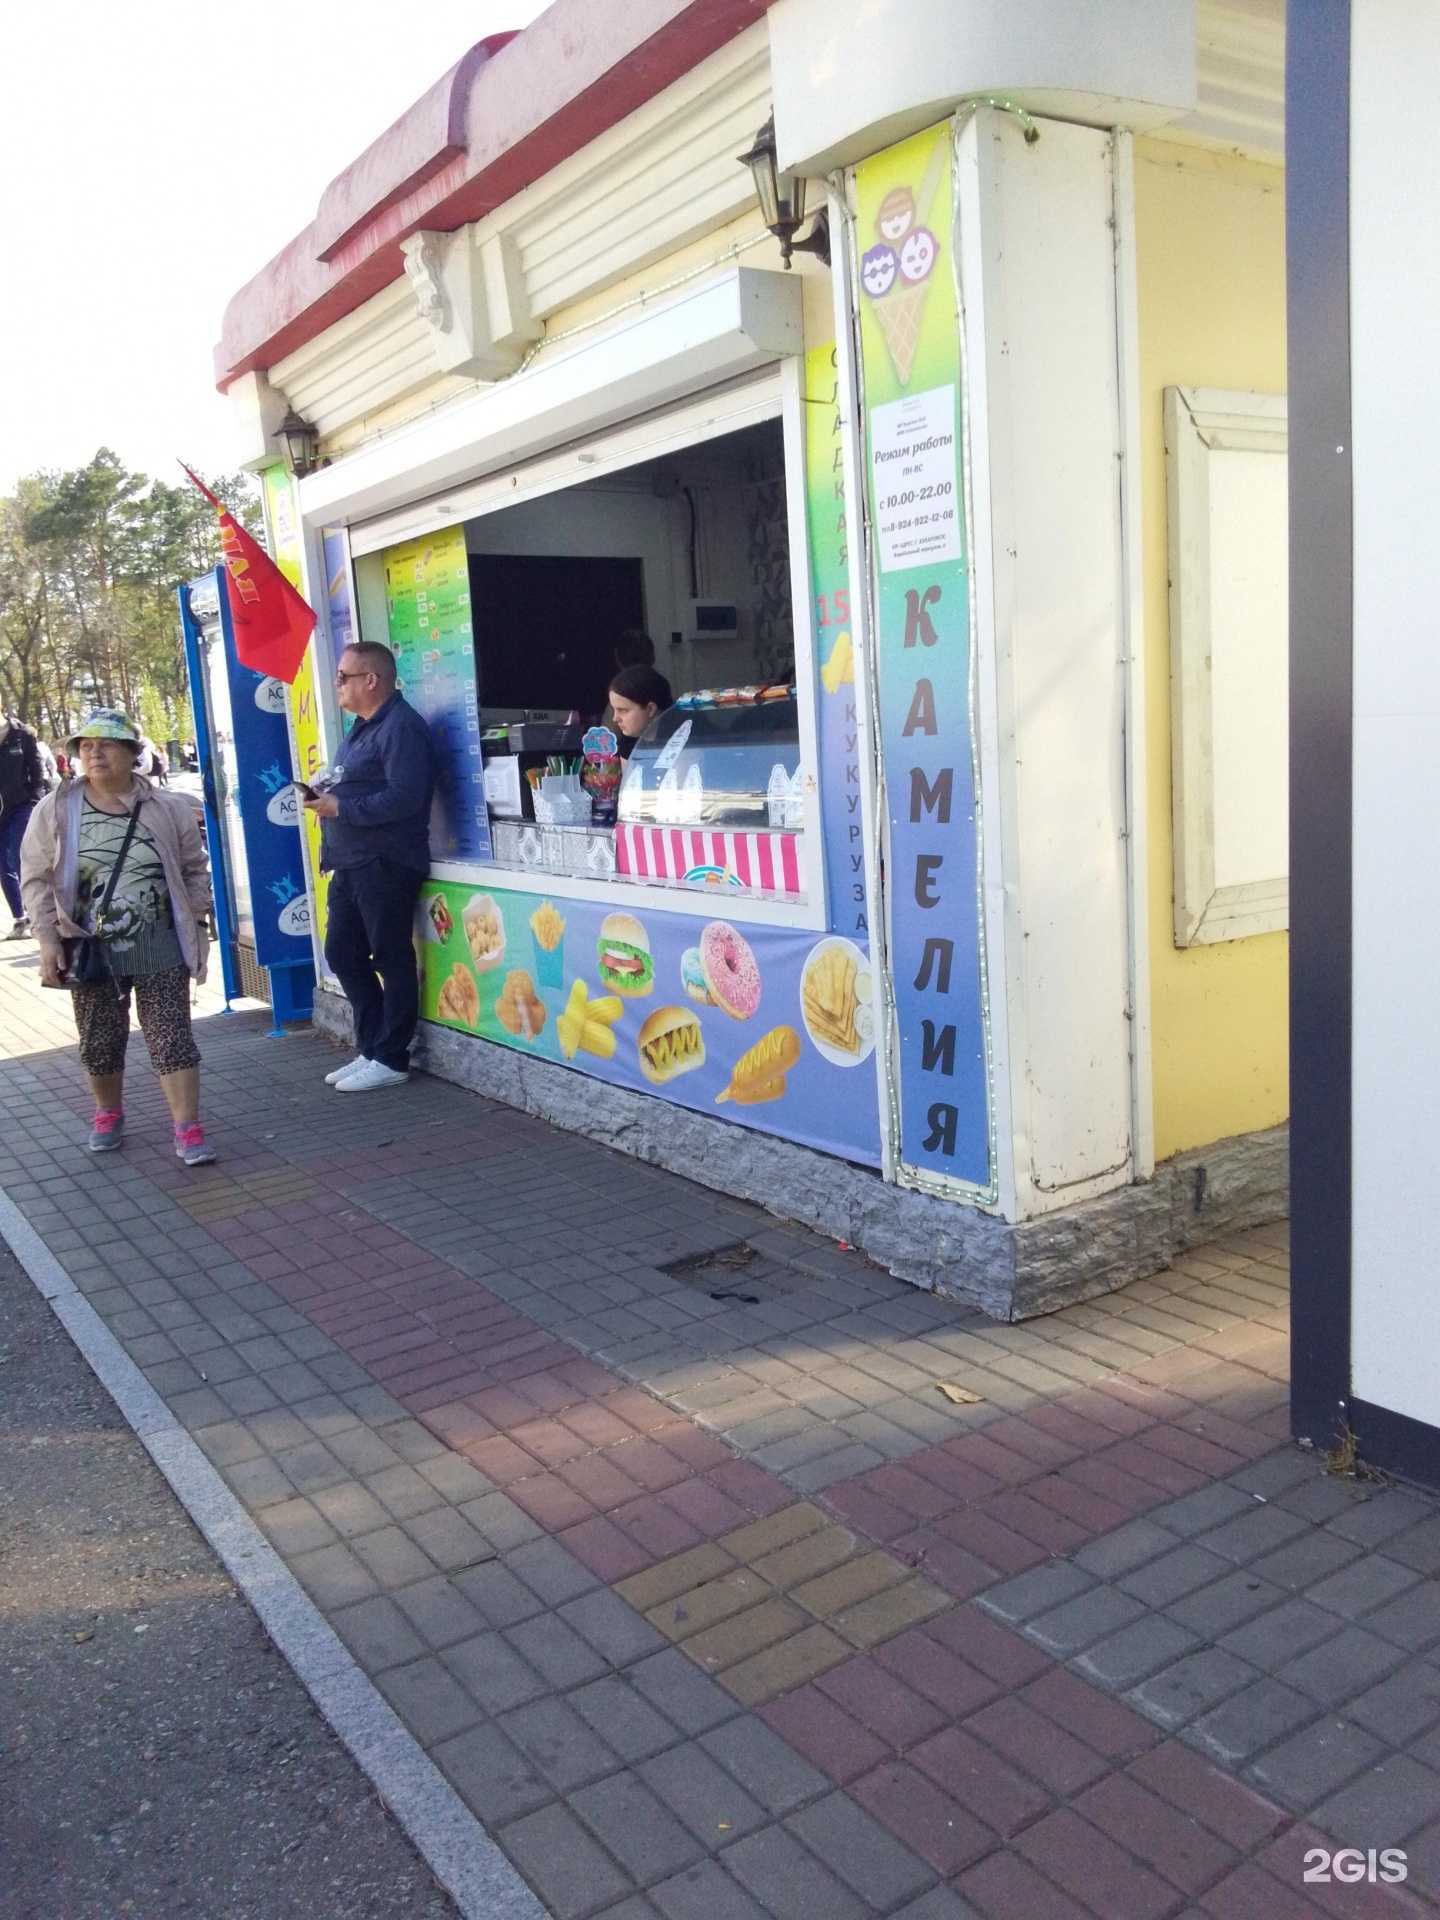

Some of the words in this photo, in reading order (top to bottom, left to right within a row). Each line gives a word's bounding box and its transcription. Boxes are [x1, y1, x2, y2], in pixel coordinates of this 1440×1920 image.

[874, 445, 911, 465] Режим
[912, 434, 953, 458] работы
[887, 481, 953, 509] 10.00-22.00
[845, 703, 868, 932] КУКУРУЗА
[902, 584, 960, 1158] КАМЕЛИЯ
